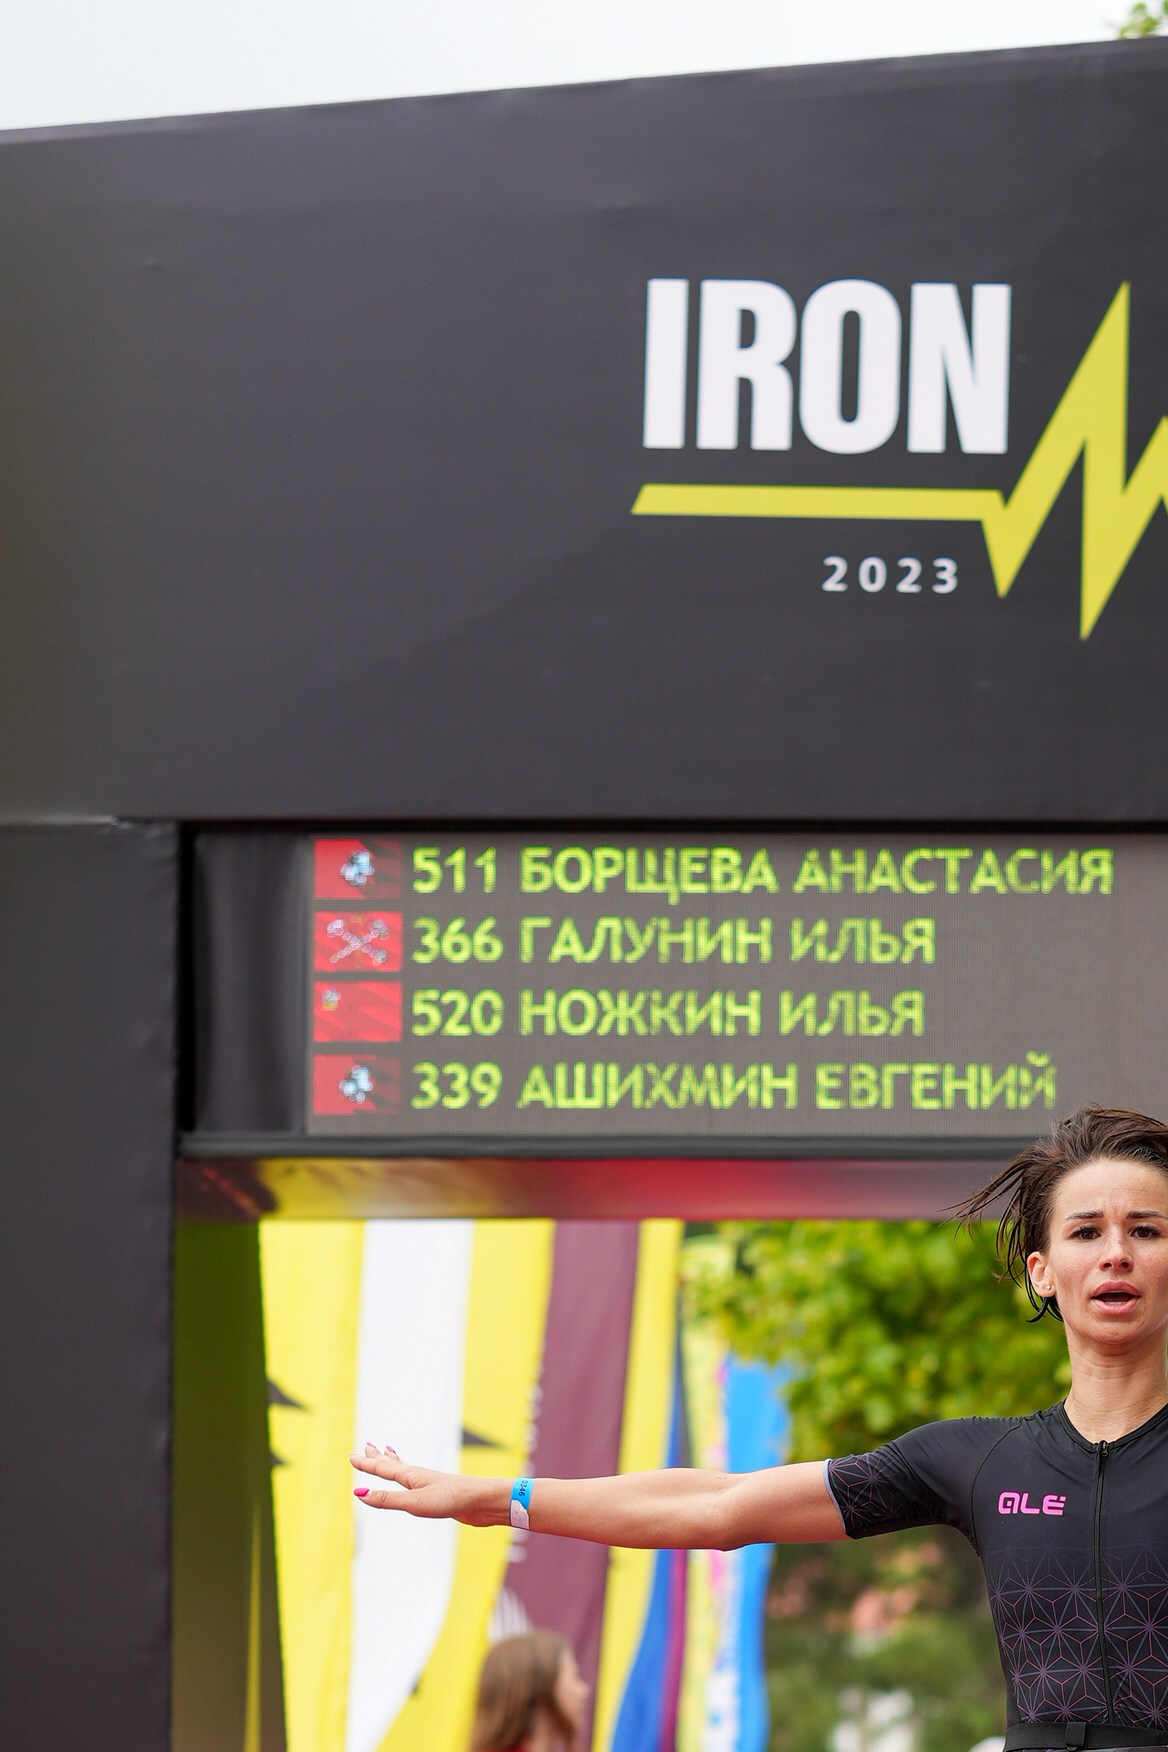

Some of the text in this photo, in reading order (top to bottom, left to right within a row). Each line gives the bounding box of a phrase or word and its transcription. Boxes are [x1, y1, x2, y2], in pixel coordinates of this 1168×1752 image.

[642, 277, 1013, 455] IRON
[821, 555, 960, 595] 2023
[412, 847, 497, 893] 511
[519, 847, 780, 904] БОРЩЕВА
[793, 848, 1114, 895] АНАСТАСИЯ
[412, 916, 503, 964] 366
[519, 916, 773, 964] ГАЛУНИН
[789, 917, 936, 964] ИЛЬЯ
[412, 989, 503, 1037] 520
[519, 989, 762, 1037] НОЖКИН
[778, 989, 926, 1037] ИЛЬЯ
[412, 1062, 503, 1110] 339
[516, 1062, 799, 1110] АШИХМИН
[815, 1051, 1056, 1110] ЕВГЕНИЙ
